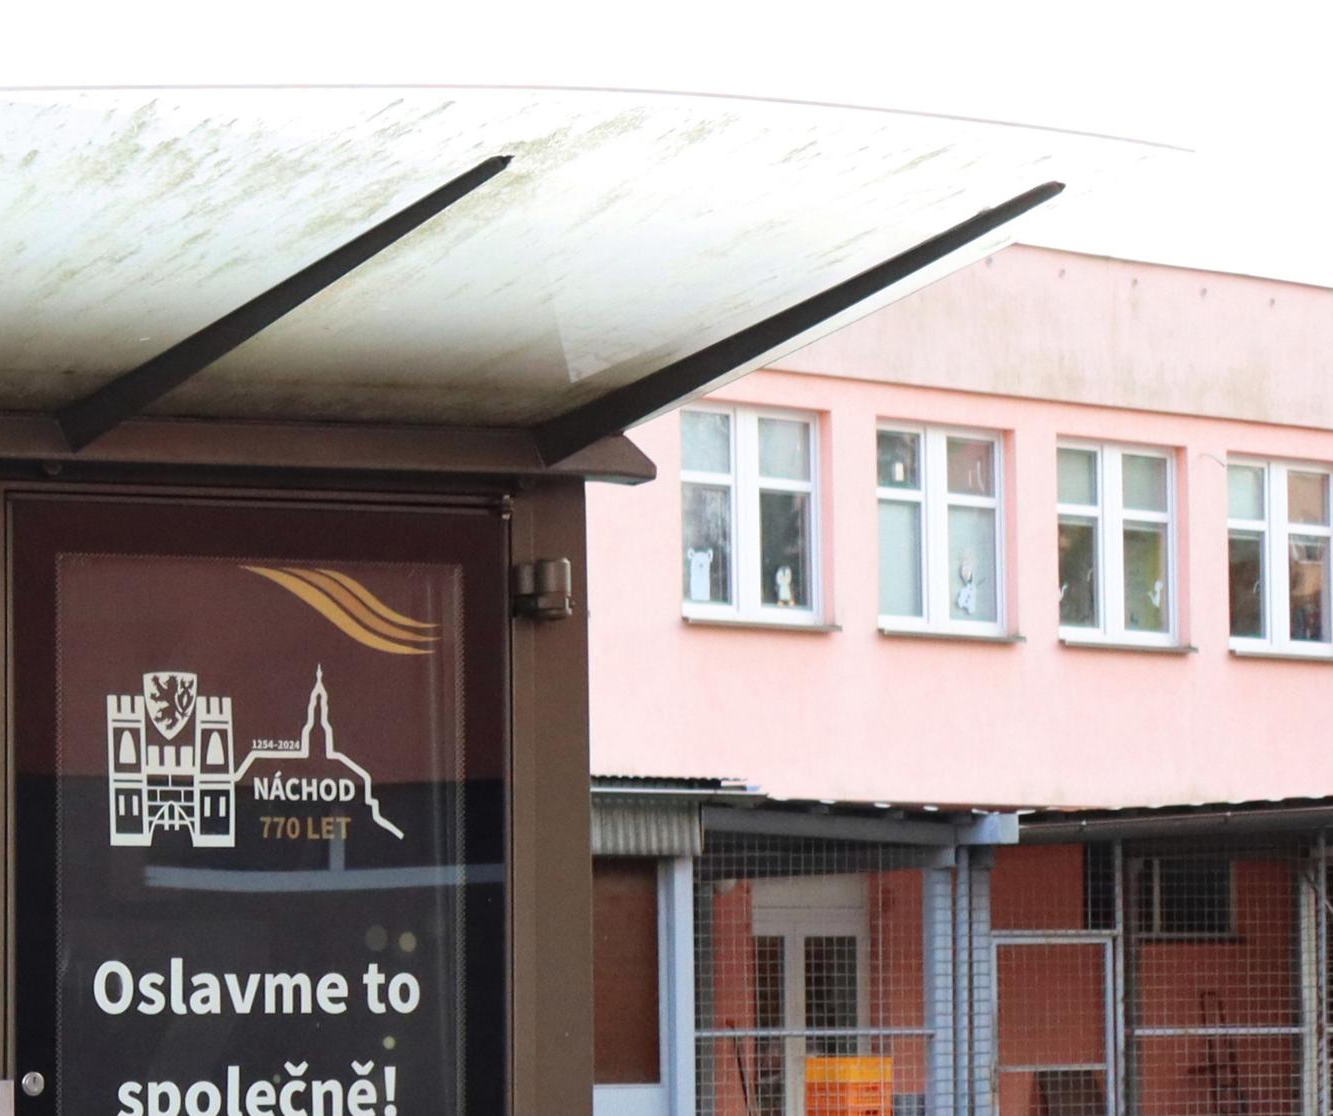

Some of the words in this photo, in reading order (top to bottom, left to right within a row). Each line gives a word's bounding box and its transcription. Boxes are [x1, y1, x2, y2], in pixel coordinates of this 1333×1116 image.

[252, 739, 300, 750] 1254-2024
[254, 771, 355, 801] NÁCHOD
[261, 817, 300, 839] 770
[306, 817, 350, 839] LET
[94, 958, 348, 1014] Oslavme
[363, 964, 420, 1013] to
